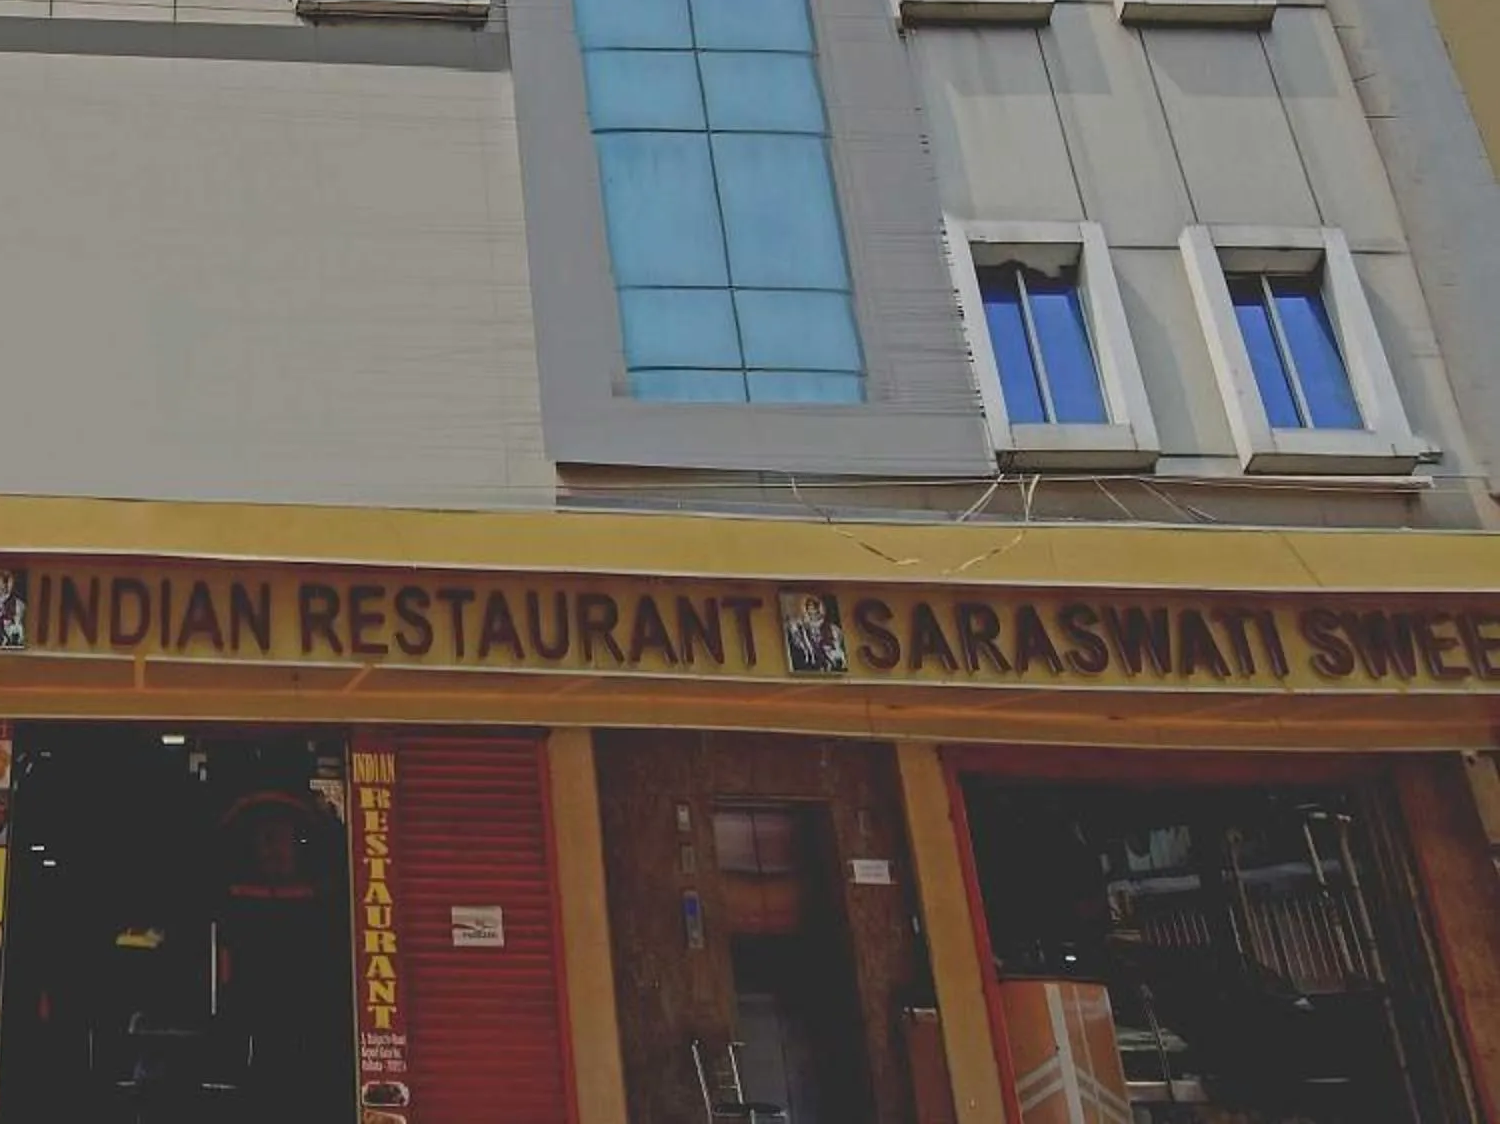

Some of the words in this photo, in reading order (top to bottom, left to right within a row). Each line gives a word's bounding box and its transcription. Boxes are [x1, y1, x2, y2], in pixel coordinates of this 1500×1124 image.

[35, 575, 271, 654] INDIAN
[298, 582, 763, 667] RESTAURANT
[853, 598, 1290, 680] SARASWATI
[352, 753, 395, 783] INDIAN
[359, 787, 399, 1029] RESTAURANT
